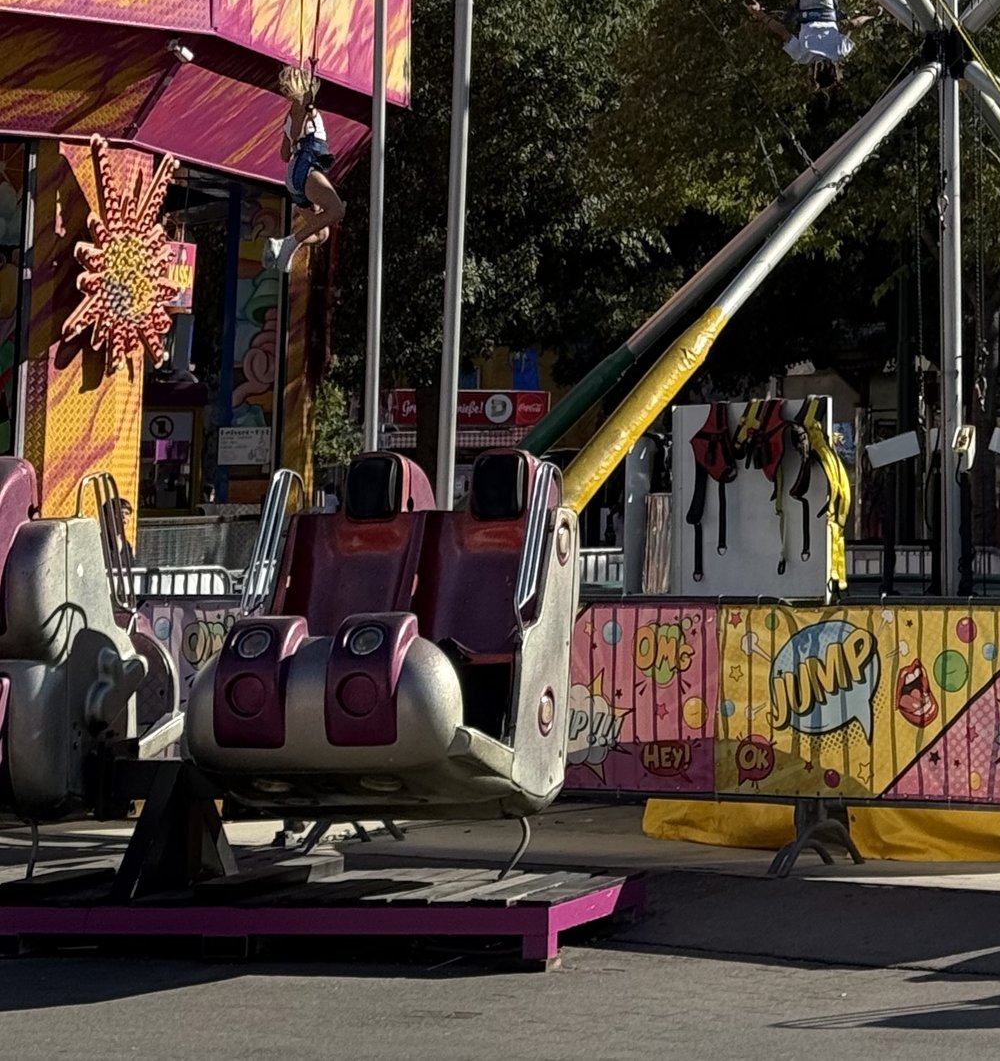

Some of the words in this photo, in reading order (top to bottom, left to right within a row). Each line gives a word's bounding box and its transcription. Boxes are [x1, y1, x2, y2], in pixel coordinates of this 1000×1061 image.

[182, 622, 224, 665] OM
[634, 625, 695, 672] OMG
[767, 627, 873, 730] JUMP
[642, 742, 691, 769] HEY!
[739, 741, 770, 770] OK
